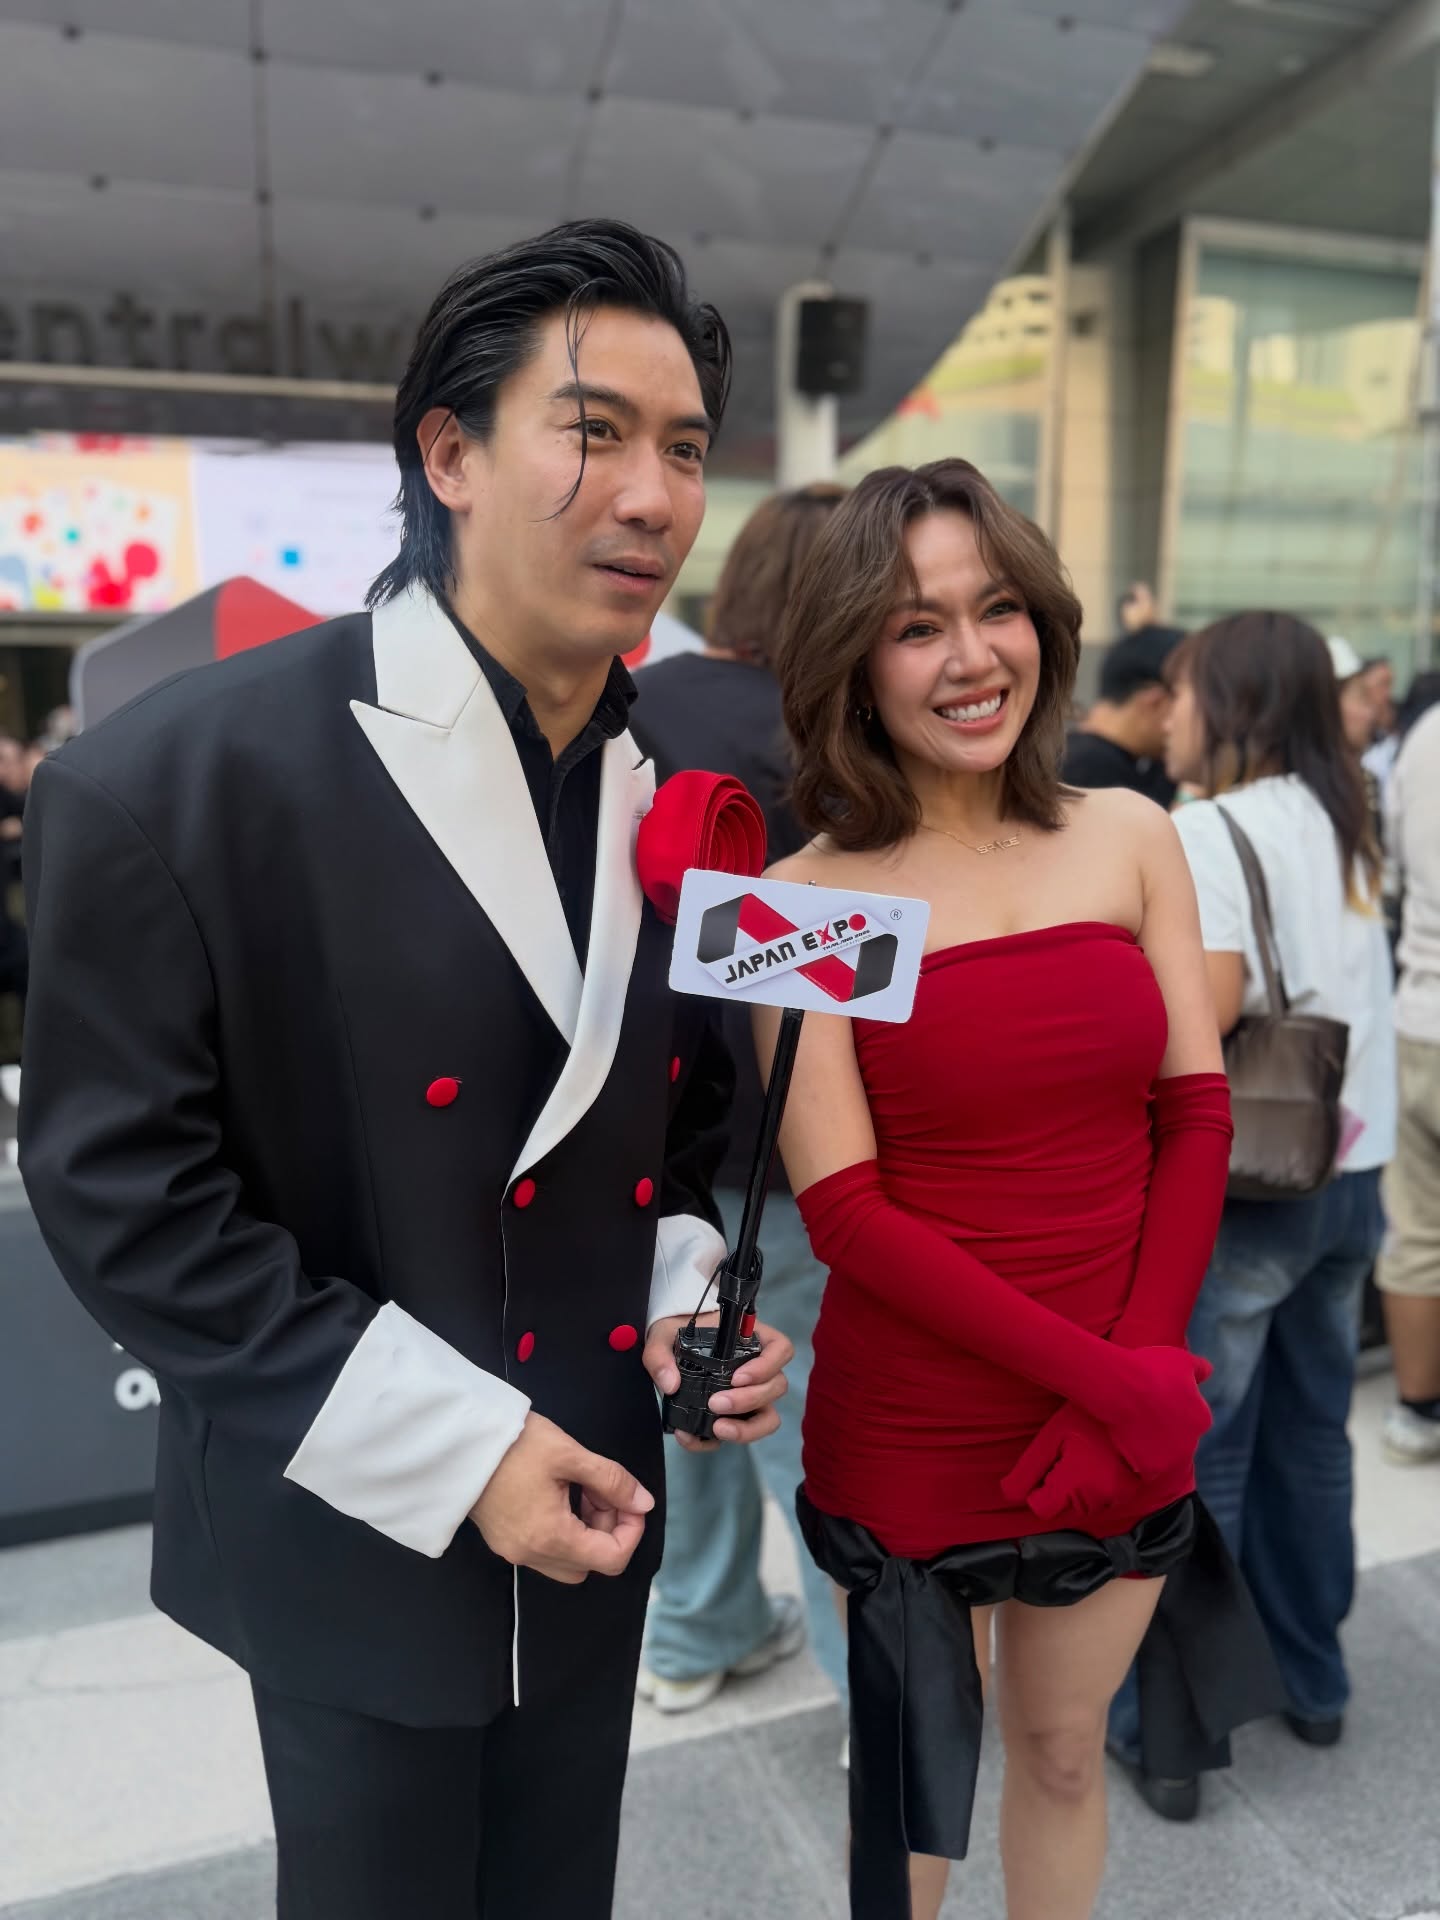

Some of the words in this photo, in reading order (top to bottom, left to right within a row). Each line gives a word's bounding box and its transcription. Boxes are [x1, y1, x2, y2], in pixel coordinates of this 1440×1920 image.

[0, 290, 404, 382] ntralw
[724, 941, 797, 984] JAPAN
[801, 914, 867, 951] EXPO
